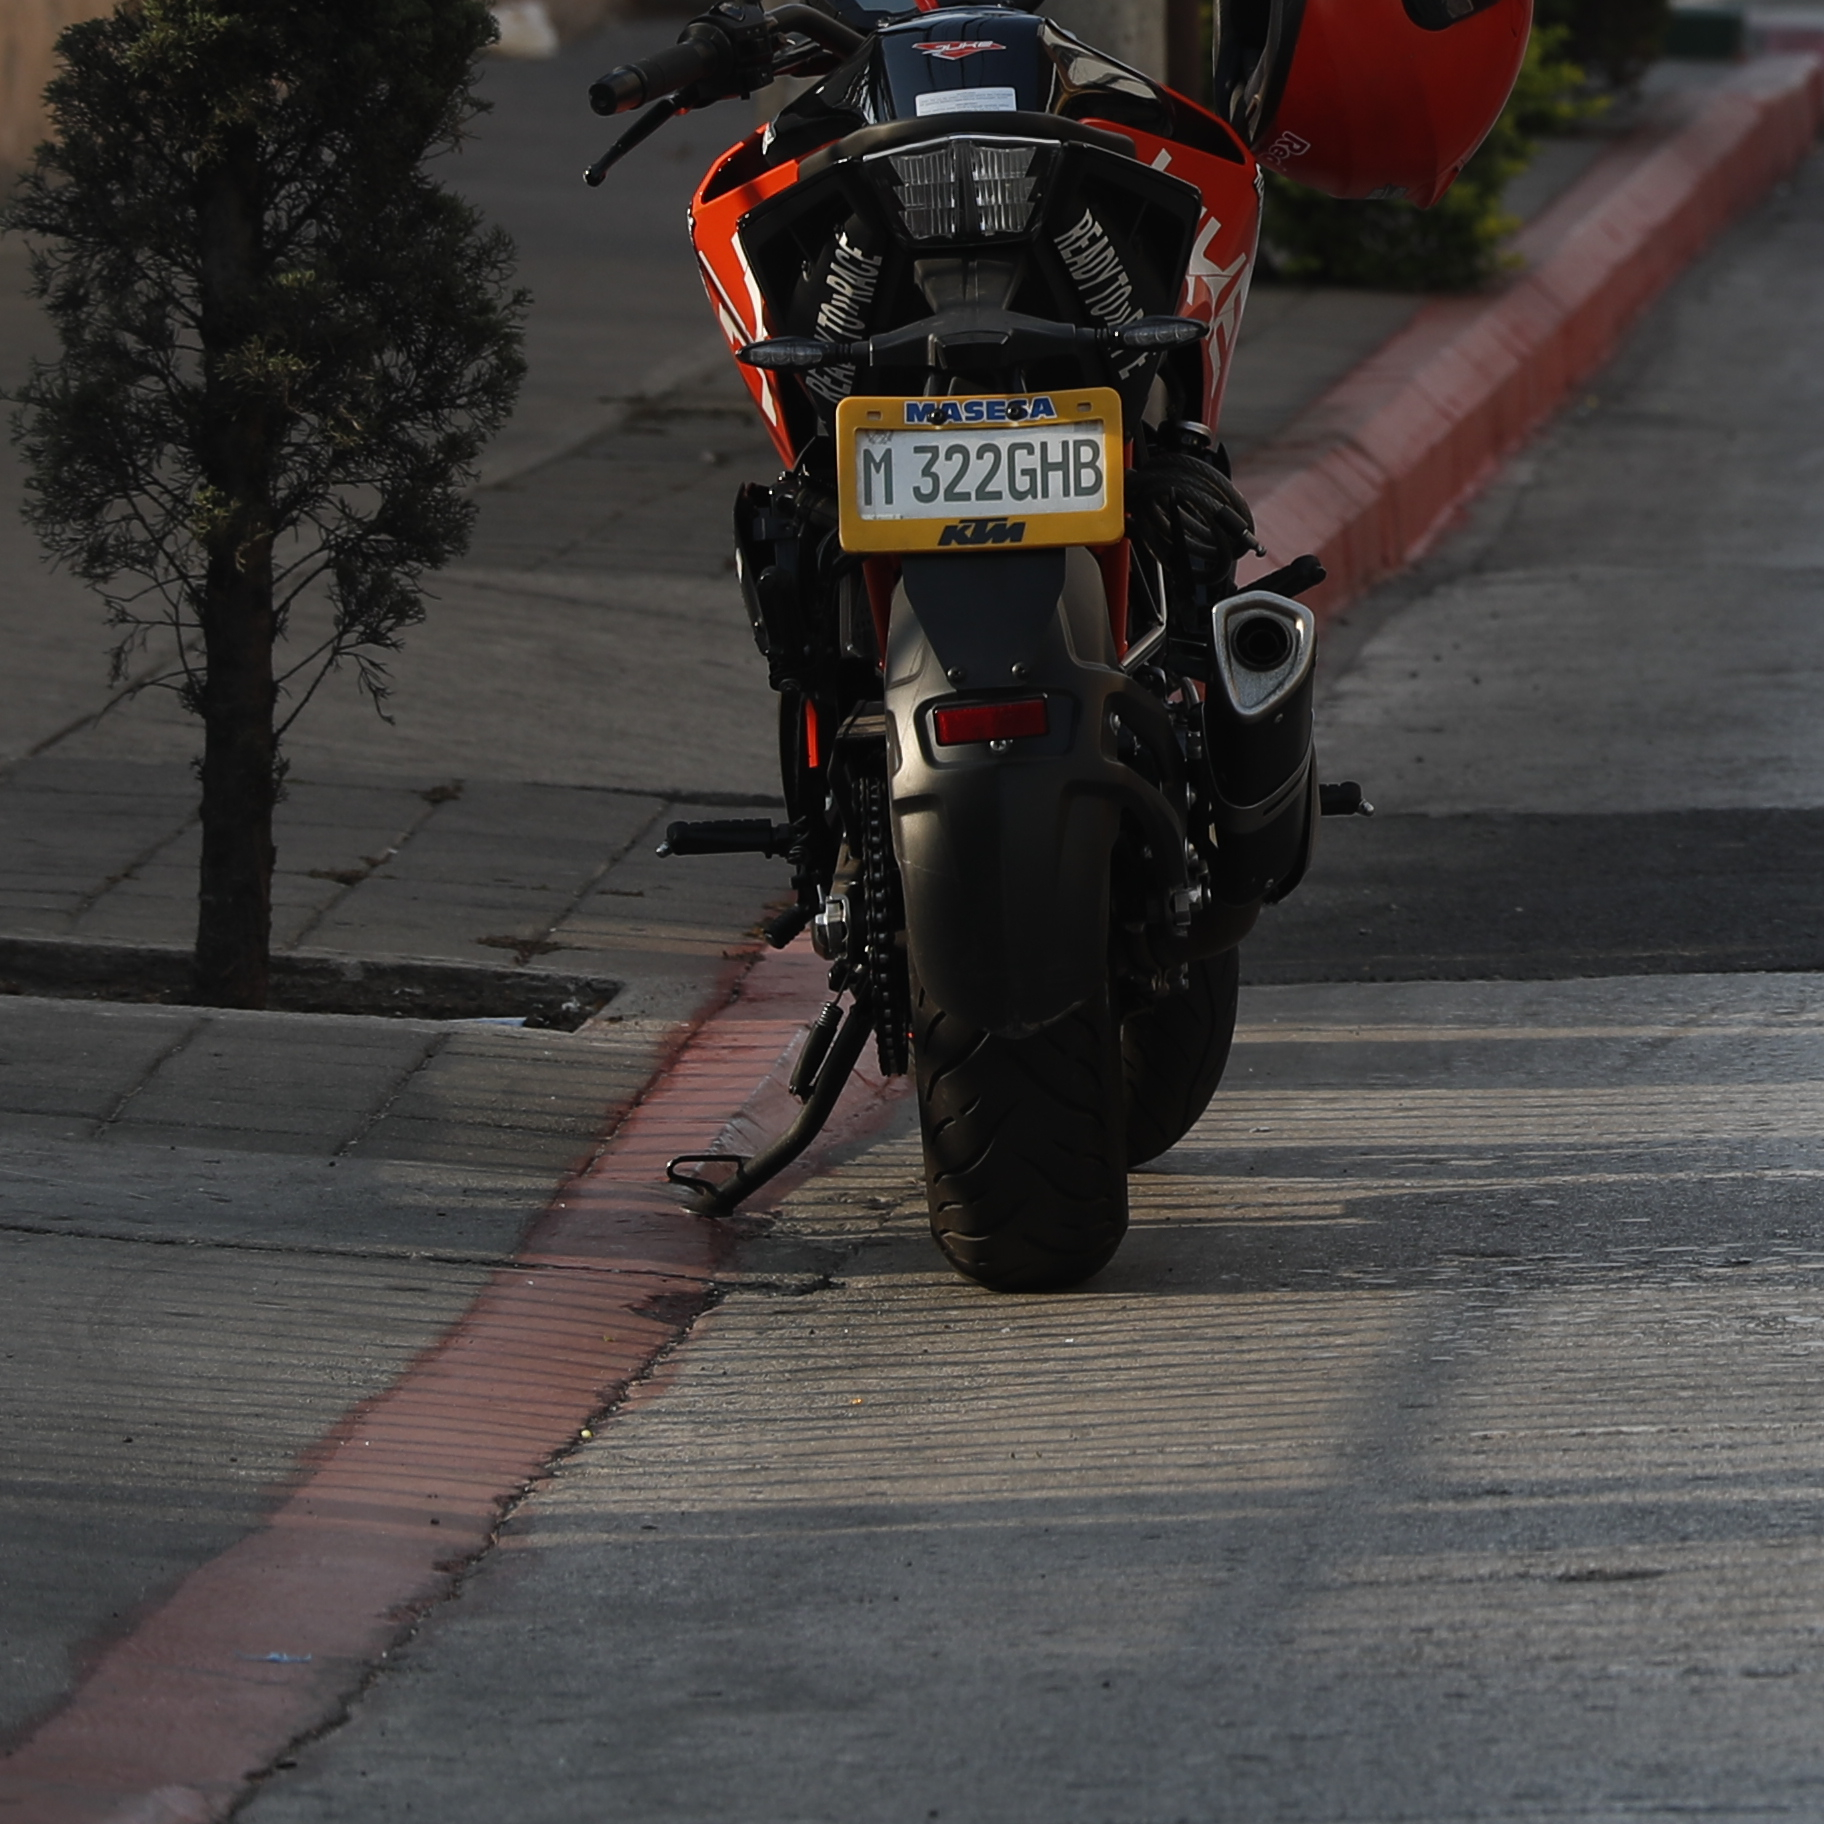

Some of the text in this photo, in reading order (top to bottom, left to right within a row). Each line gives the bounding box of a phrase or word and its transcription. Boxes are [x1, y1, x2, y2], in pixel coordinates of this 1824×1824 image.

[826, 231, 883, 304] RACE
[1053, 207, 1124, 291] READY
[1085, 271, 1133, 316] TO
[862, 438, 1104, 507] M 322GHB
[937, 517, 1027, 547] KTM
